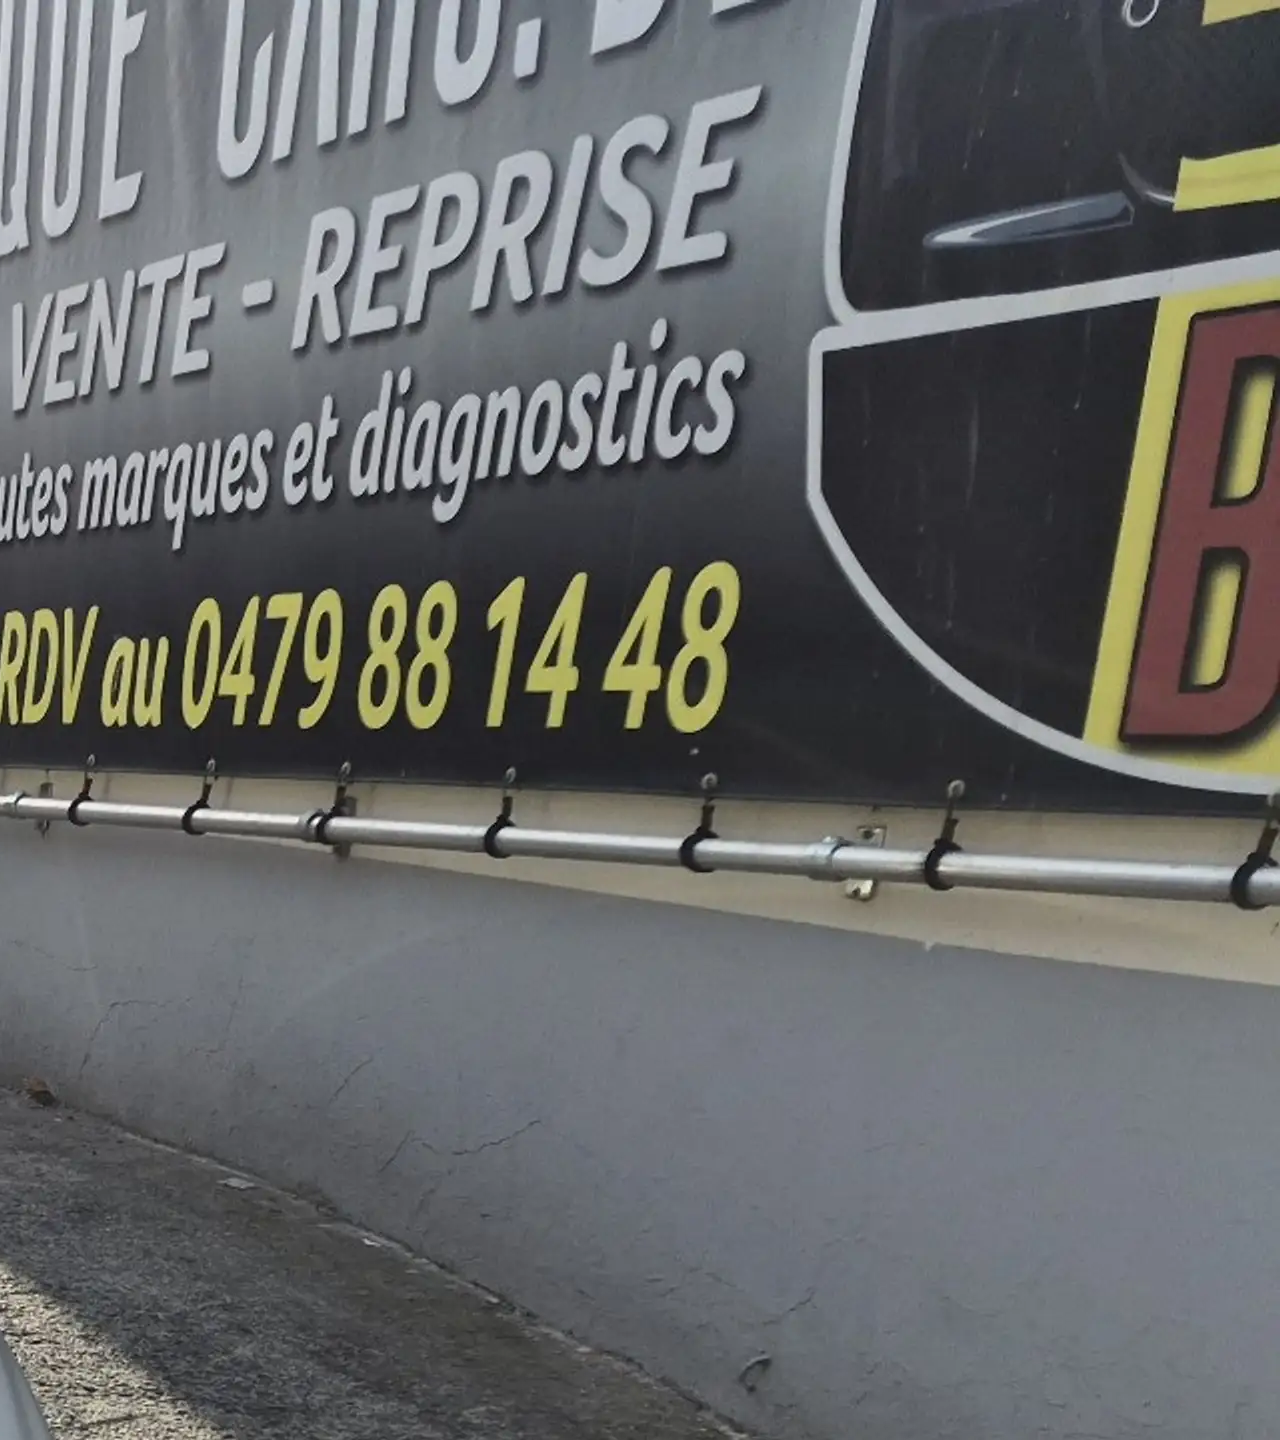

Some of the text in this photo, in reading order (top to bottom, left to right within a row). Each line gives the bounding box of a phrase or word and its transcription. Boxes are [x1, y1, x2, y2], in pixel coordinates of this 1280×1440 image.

[11, 242, 226, 412] VENTE
[291, 84, 762, 351] REPRISE
[76, 428, 273, 551] marques
[282, 395, 338, 506] et
[349, 317, 745, 523] diagnostics
[99, 636, 170, 728] au
[182, 588, 343, 730] 0479
[357, 580, 457, 730] 88
[486, 572, 588, 729] 14
[601, 560, 741, 734] 48
